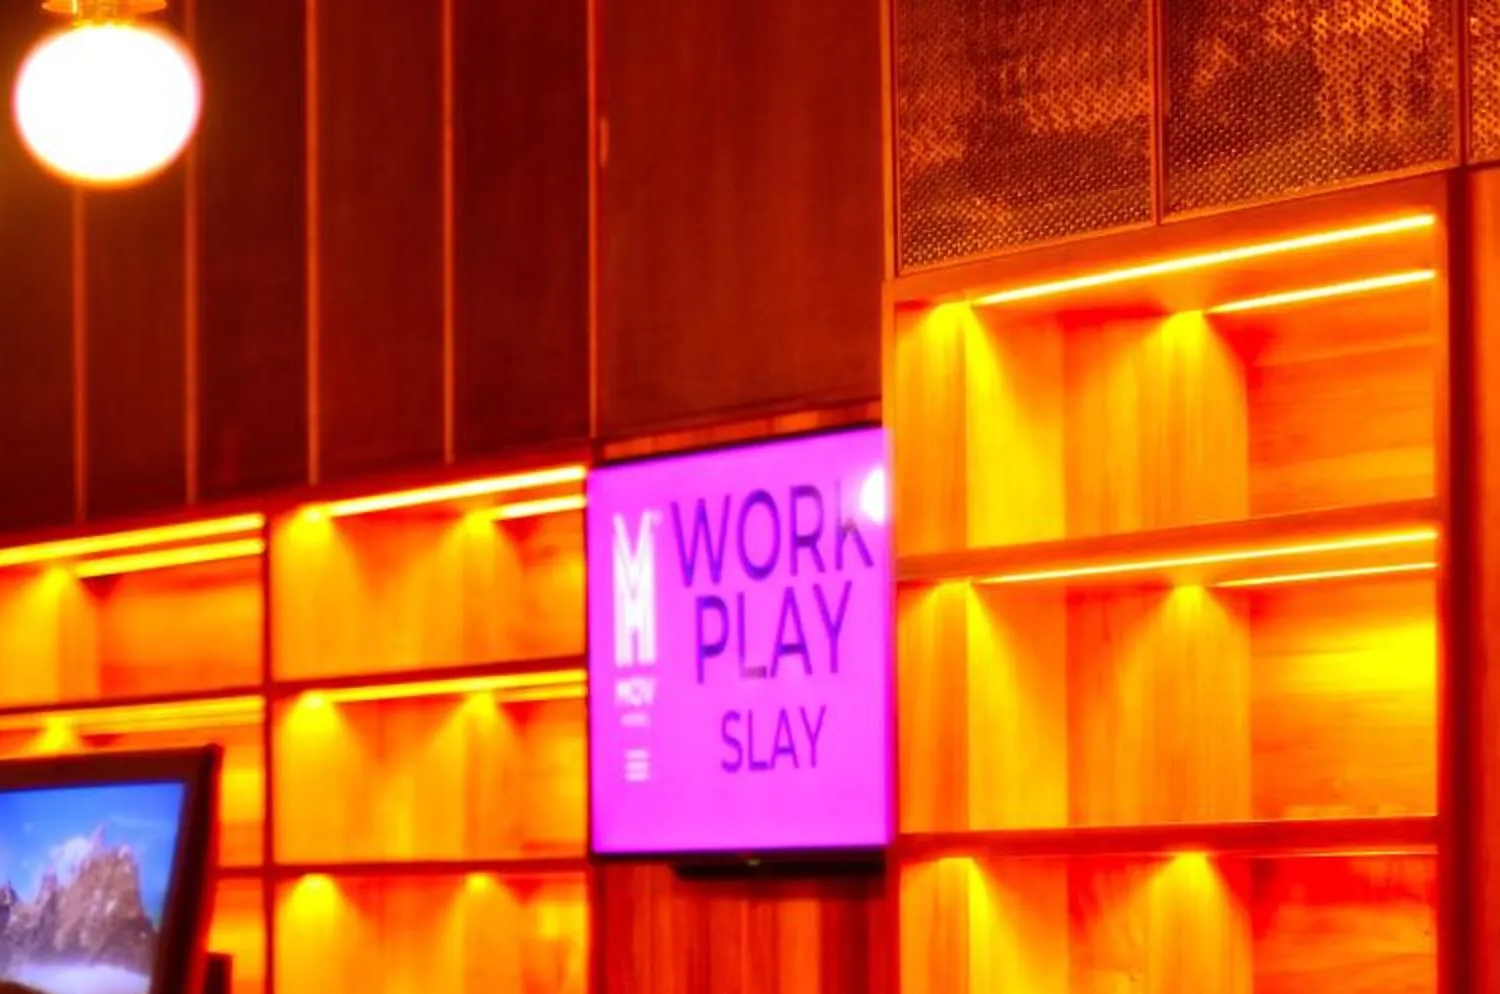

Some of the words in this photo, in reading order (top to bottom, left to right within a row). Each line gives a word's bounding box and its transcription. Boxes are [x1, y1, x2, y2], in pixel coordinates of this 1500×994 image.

[669, 480, 875, 588] WORK
[695, 580, 853, 685] PLAY
[720, 704, 827, 773] SLAY
